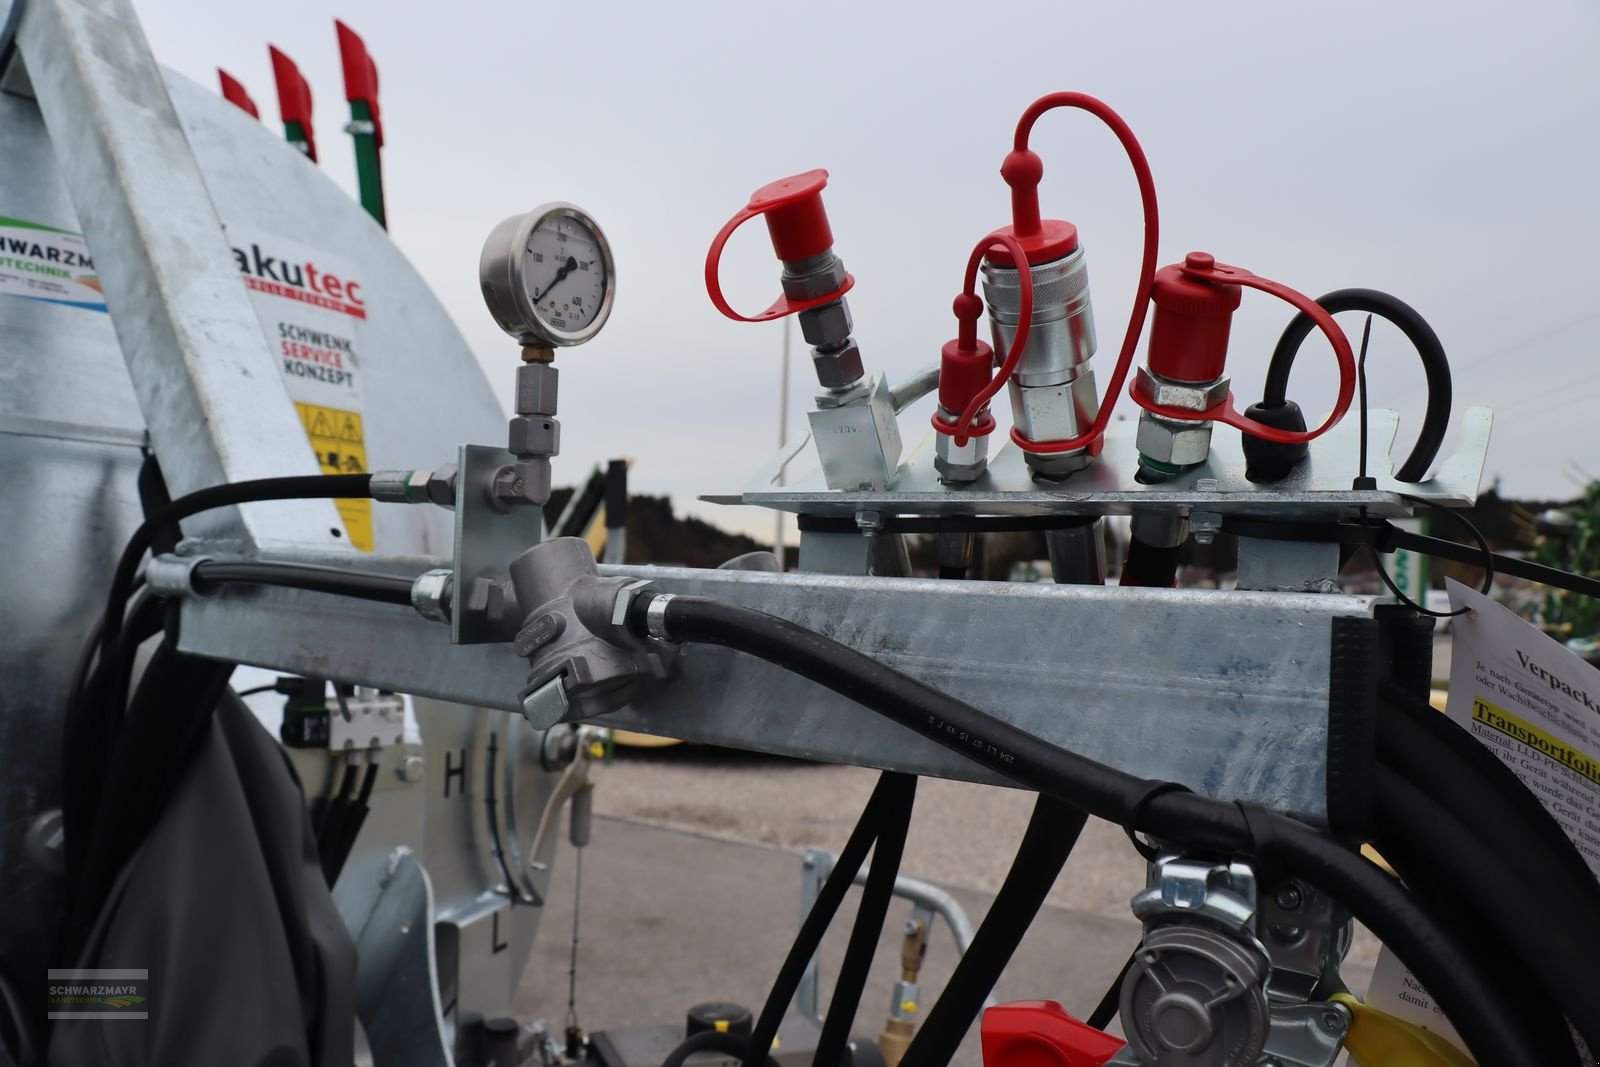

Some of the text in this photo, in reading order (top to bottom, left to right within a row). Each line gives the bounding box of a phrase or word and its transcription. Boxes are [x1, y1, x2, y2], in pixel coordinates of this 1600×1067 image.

[278, 322, 352, 353] SCHWENK
[281, 340, 343, 369] SERVICE
[283, 359, 353, 388] KONZEPT
[1474, 701, 1600, 781] Transportfoli
[444, 748, 466, 798] H
[1533, 780, 1564, 800] wurde
[492, 912, 507, 955] L
[1399, 991, 1428, 1009] damit
